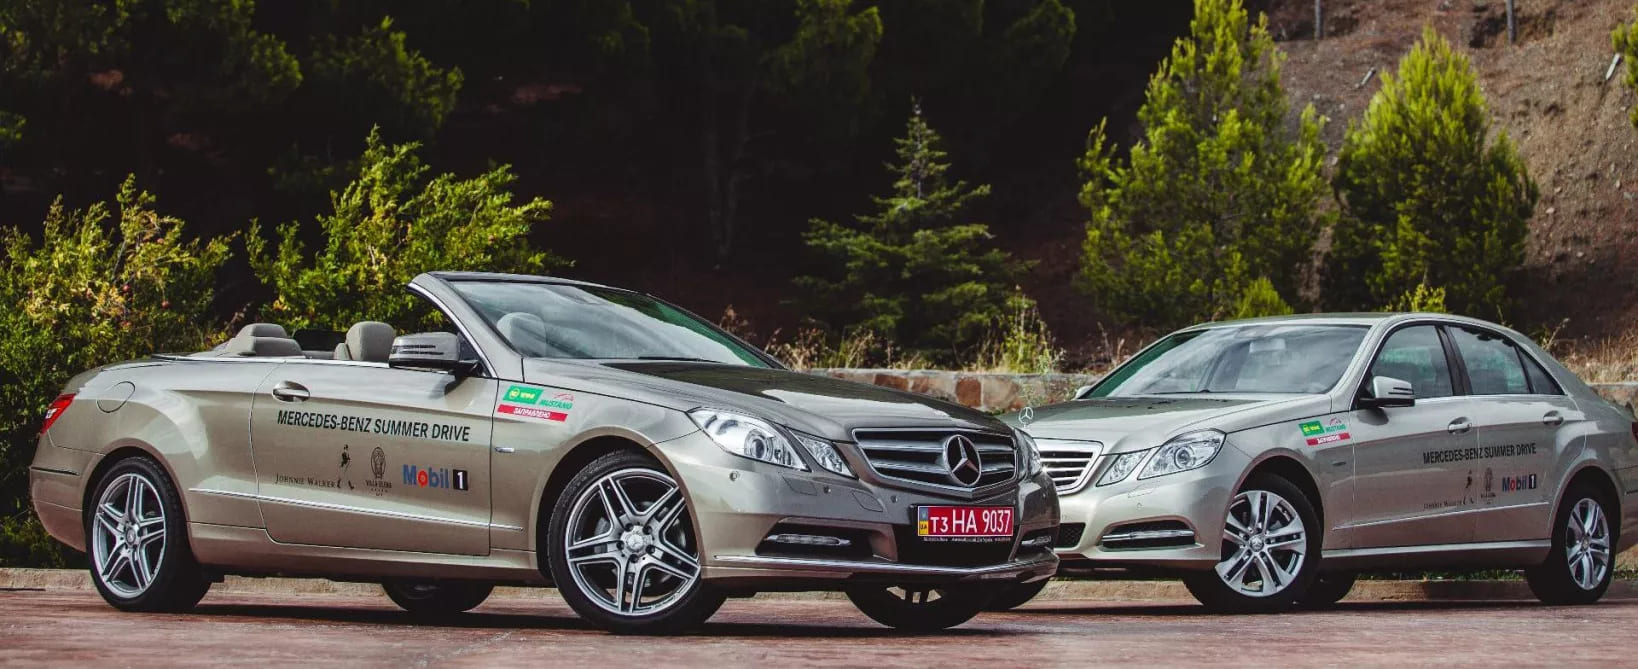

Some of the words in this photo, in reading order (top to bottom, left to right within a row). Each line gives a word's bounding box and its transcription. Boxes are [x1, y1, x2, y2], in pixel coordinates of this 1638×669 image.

[539, 399, 573, 410] MUSTANG
[277, 410, 371, 433] MERCEDES-BENZ
[373, 418, 429, 438] SUMMER
[431, 423, 471, 442] DRIVE
[1423, 447, 1483, 464] MERCEDES-BENZ
[1484, 444, 1515, 459] SUMMER
[1516, 442, 1537, 456] DRIVE
[403, 464, 449, 489] Mobil
[1502, 475, 1528, 492] Mobil
[952, 509, 978, 533] HA
[982, 510, 1011, 533] 9037
